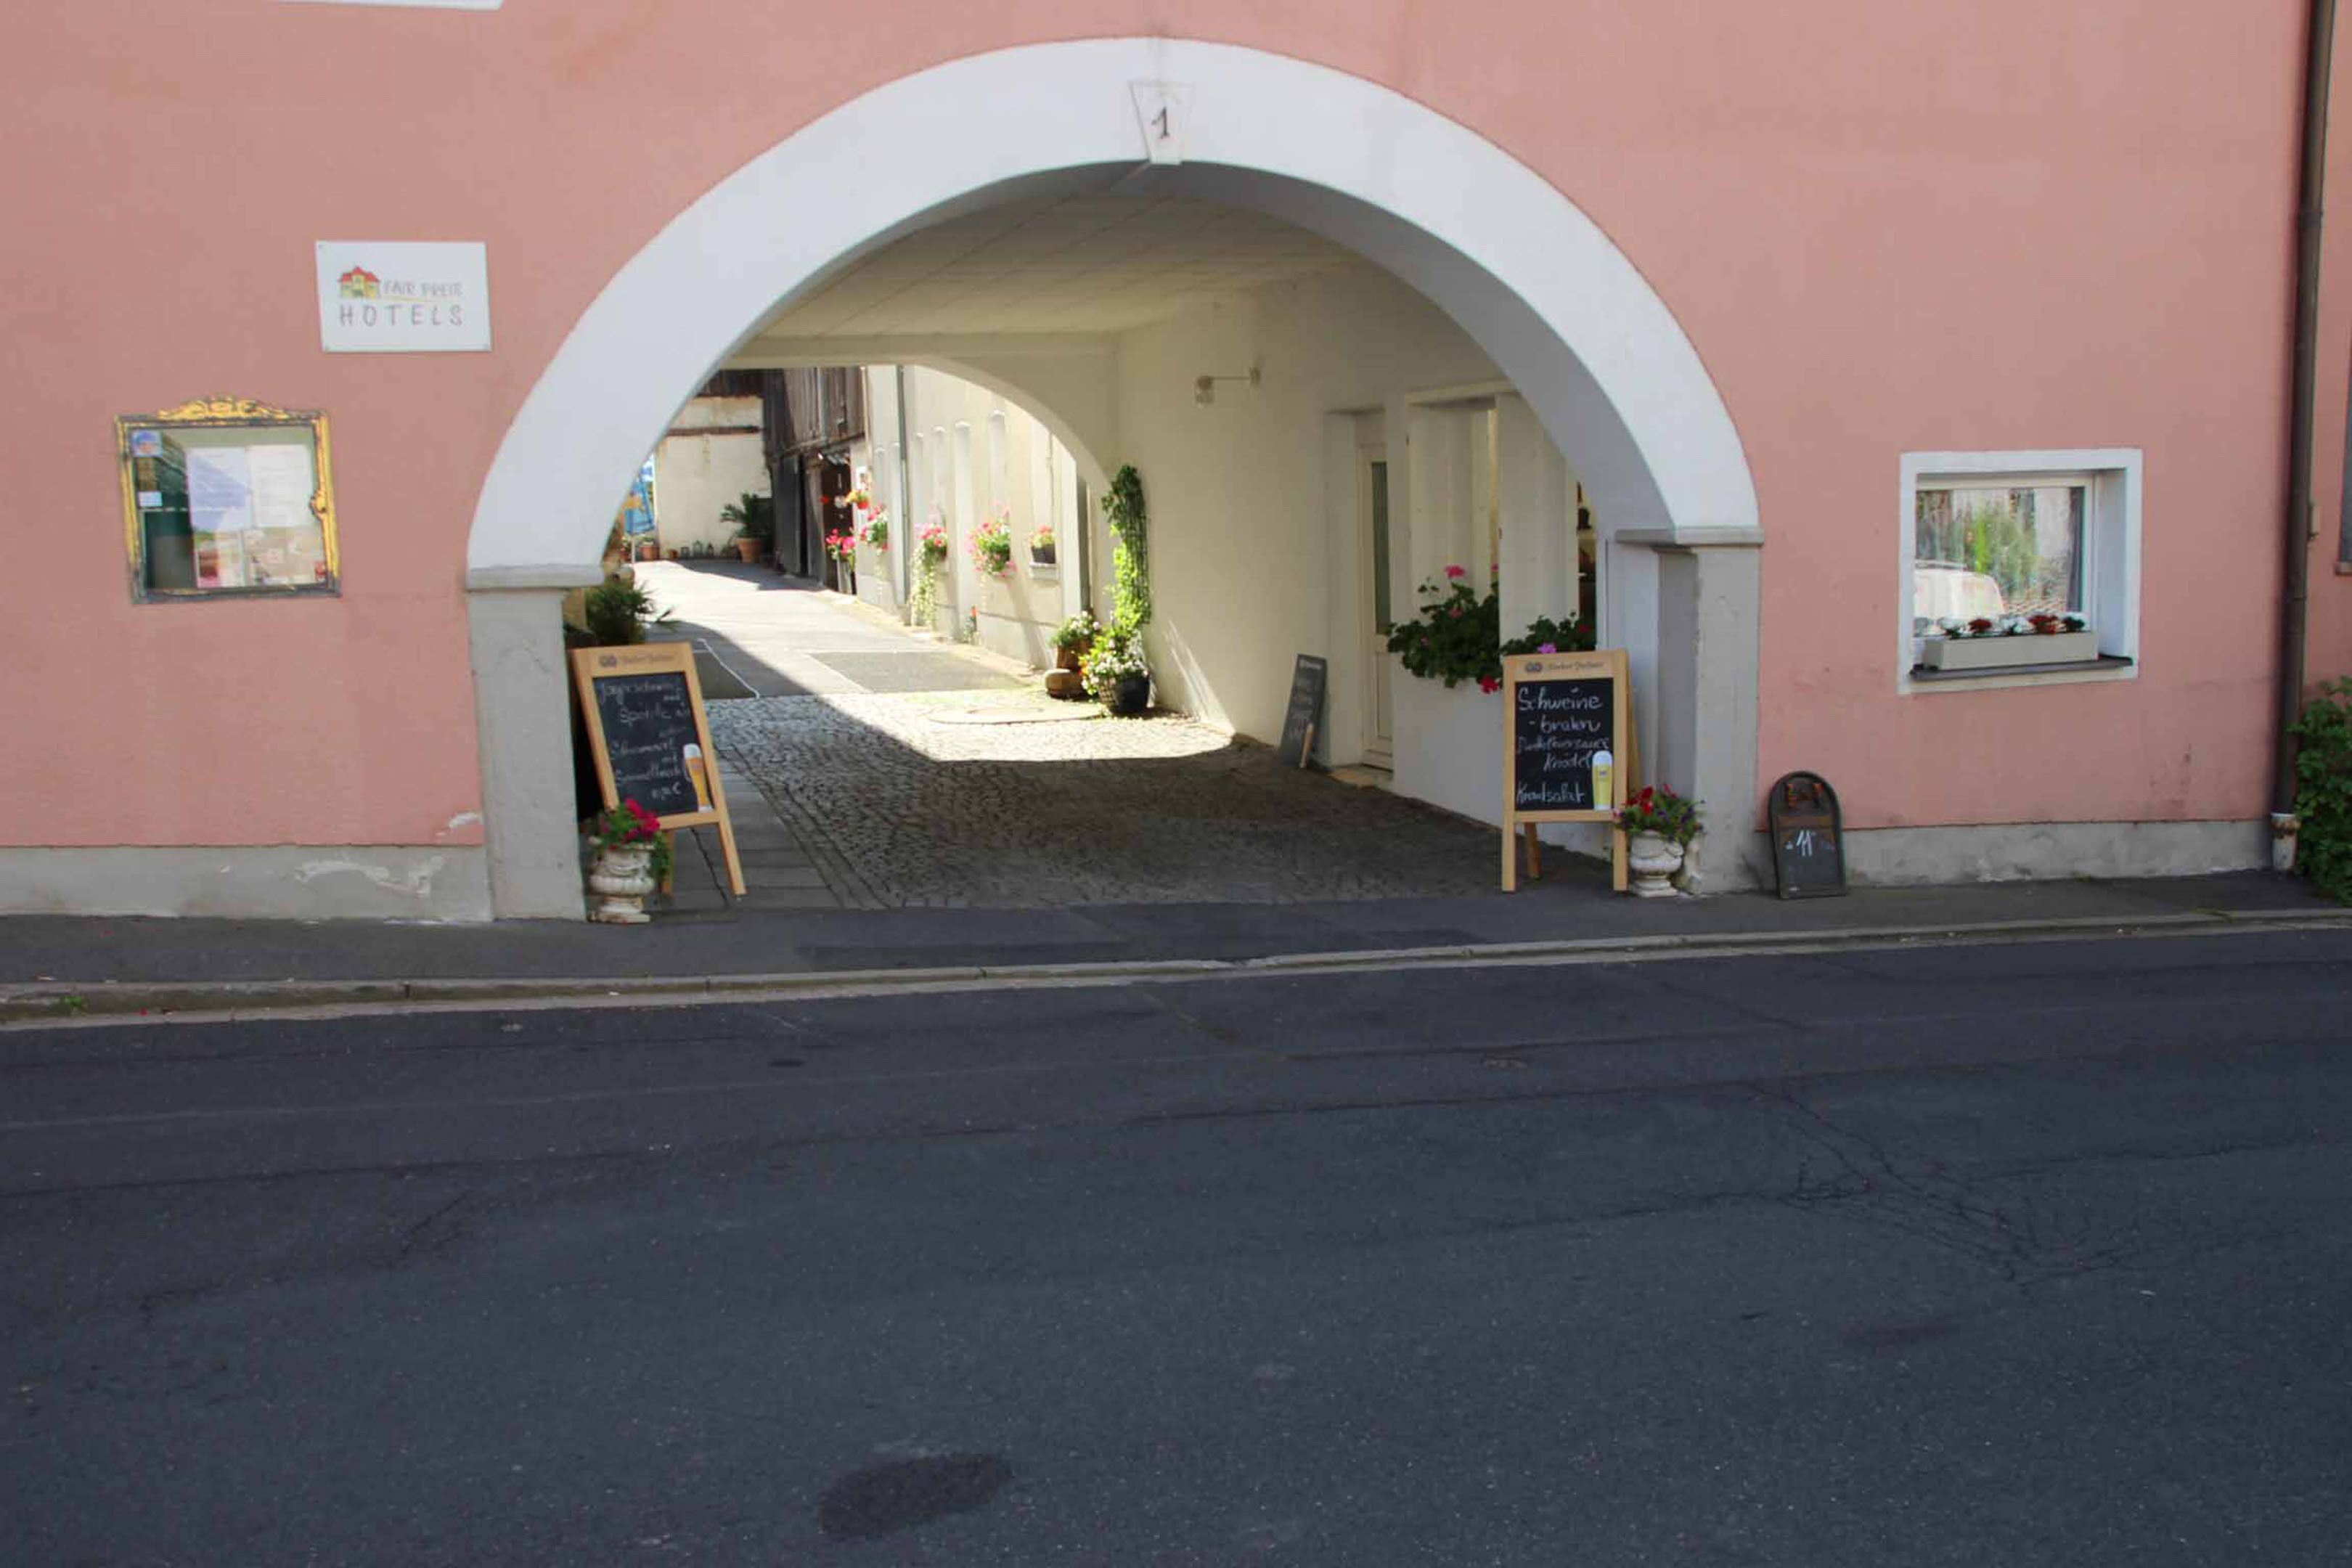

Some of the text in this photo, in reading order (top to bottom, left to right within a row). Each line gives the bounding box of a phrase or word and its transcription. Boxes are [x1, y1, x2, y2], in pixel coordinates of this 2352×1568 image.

[1151, 106, 1170, 139] 1
[339, 303, 463, 327] HOTELS
[1518, 685, 1602, 711] Schweine
